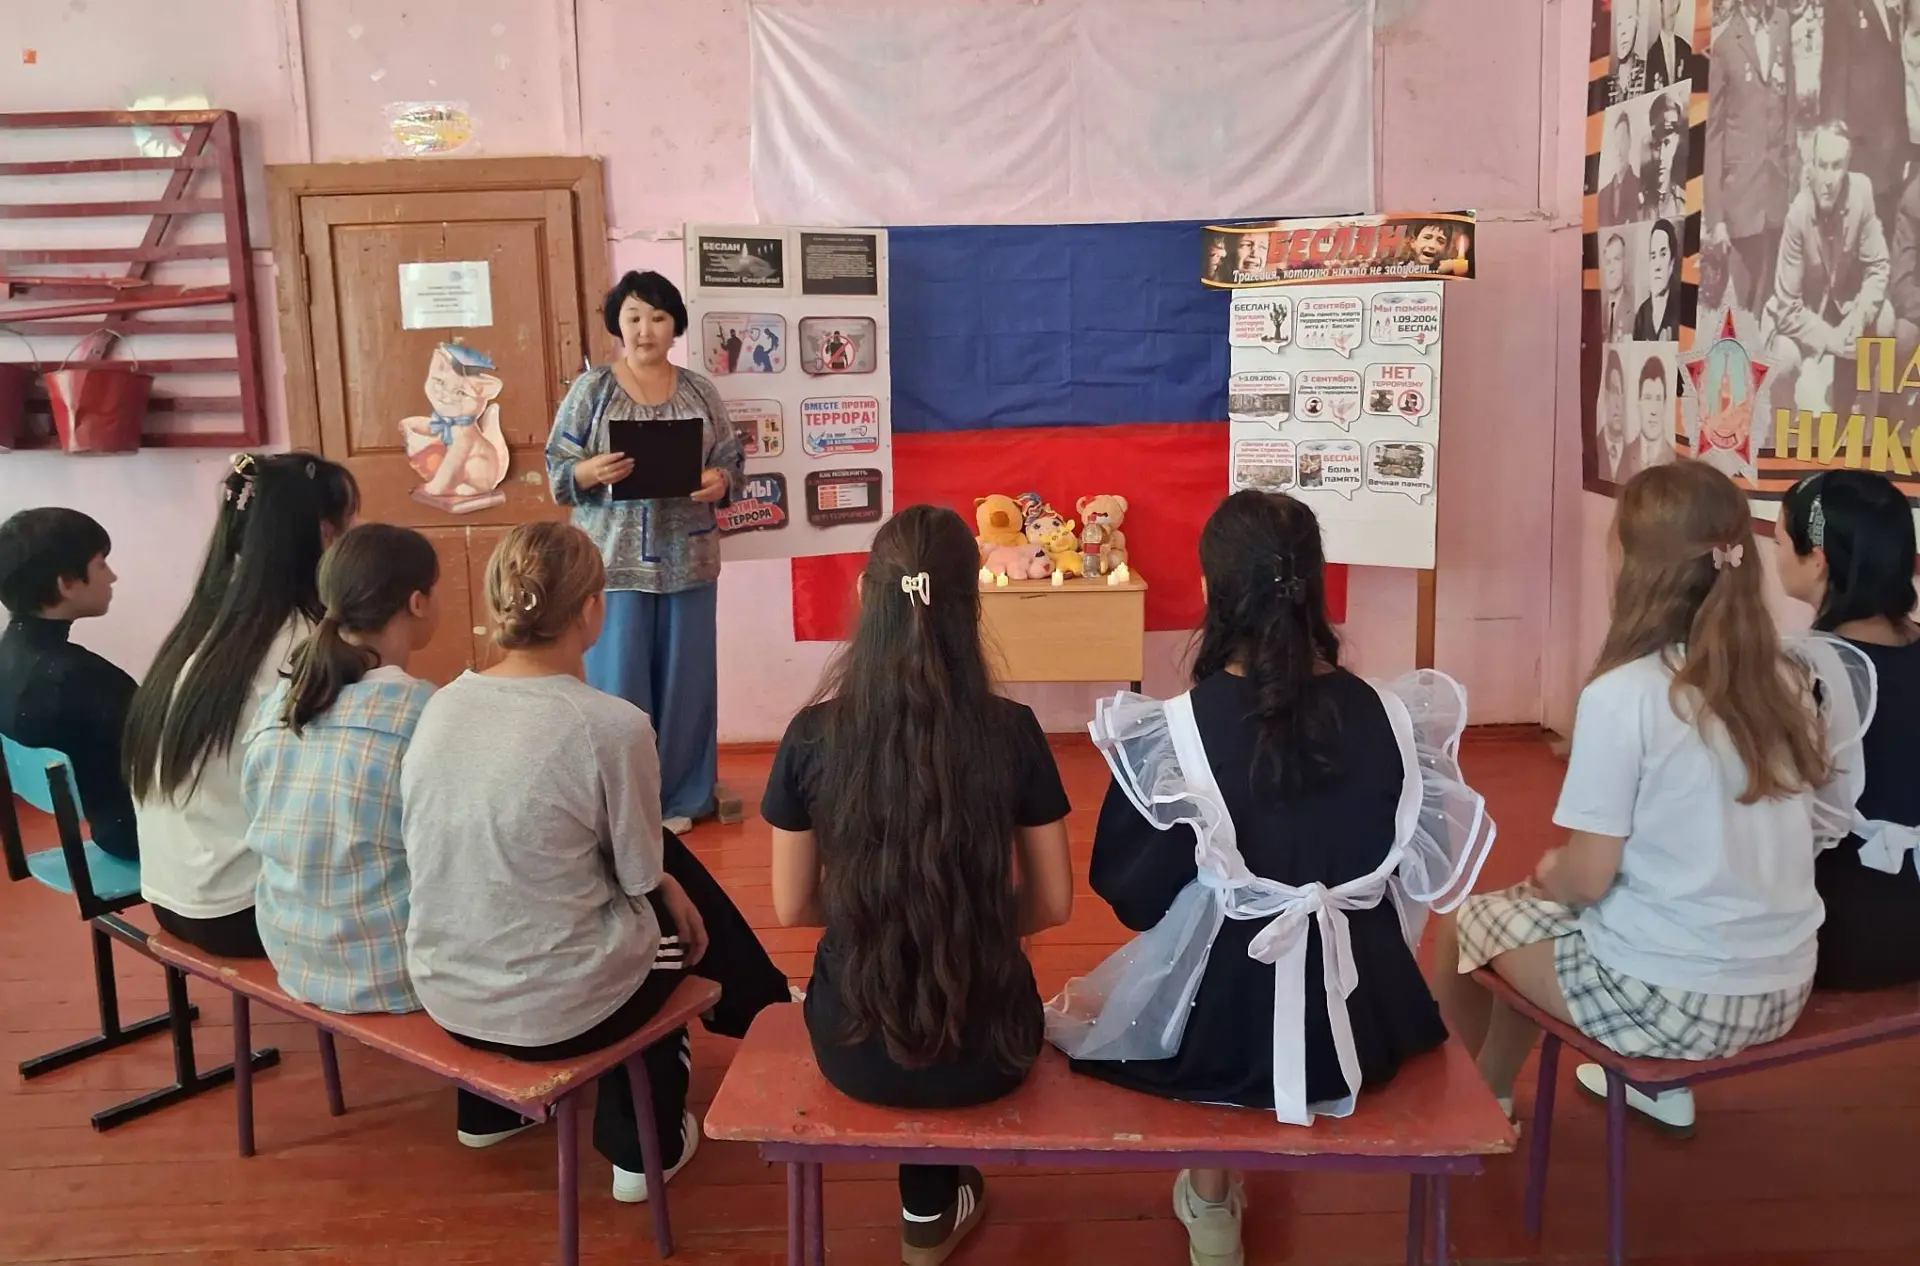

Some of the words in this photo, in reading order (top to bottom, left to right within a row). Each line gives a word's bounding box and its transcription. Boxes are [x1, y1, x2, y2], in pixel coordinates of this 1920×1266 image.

[703, 242, 741, 252] БЕСЛАН
[1265, 224, 1408, 264] БЕСЛАН
[1232, 270, 1280, 284] Трагедия,
[1283, 268, 1329, 279] которую
[1332, 266, 1367, 276] никто
[1369, 265, 1382, 275] не
[1234, 303, 1270, 311] БЕСЛАН
[1304, 302, 1310, 310] 3
[1313, 301, 1356, 310] сентября
[1373, 304, 1392, 312] Мы
[1392, 315, 1438, 323] 1.09.2004
[1397, 324, 1437, 332] БЕСЛАН
[1381, 366, 1415, 379] НЕТ
[1311, 374, 1355, 383] сентября
[804, 401, 839, 411] ВМЕСТЕ
[841, 400, 877, 409] ПРОТИВ
[804, 411, 877, 426] ТЕРРОРА!
[1774, 407, 1920, 476] НИК
[1323, 454, 1360, 462] БЕСЛАН
[1327, 465, 1352, 473] Боль
[1368, 478, 1399, 486] Вечная
[743, 480, 772, 499] МЫ
[727, 508, 771, 527] ТЕРРОРА
